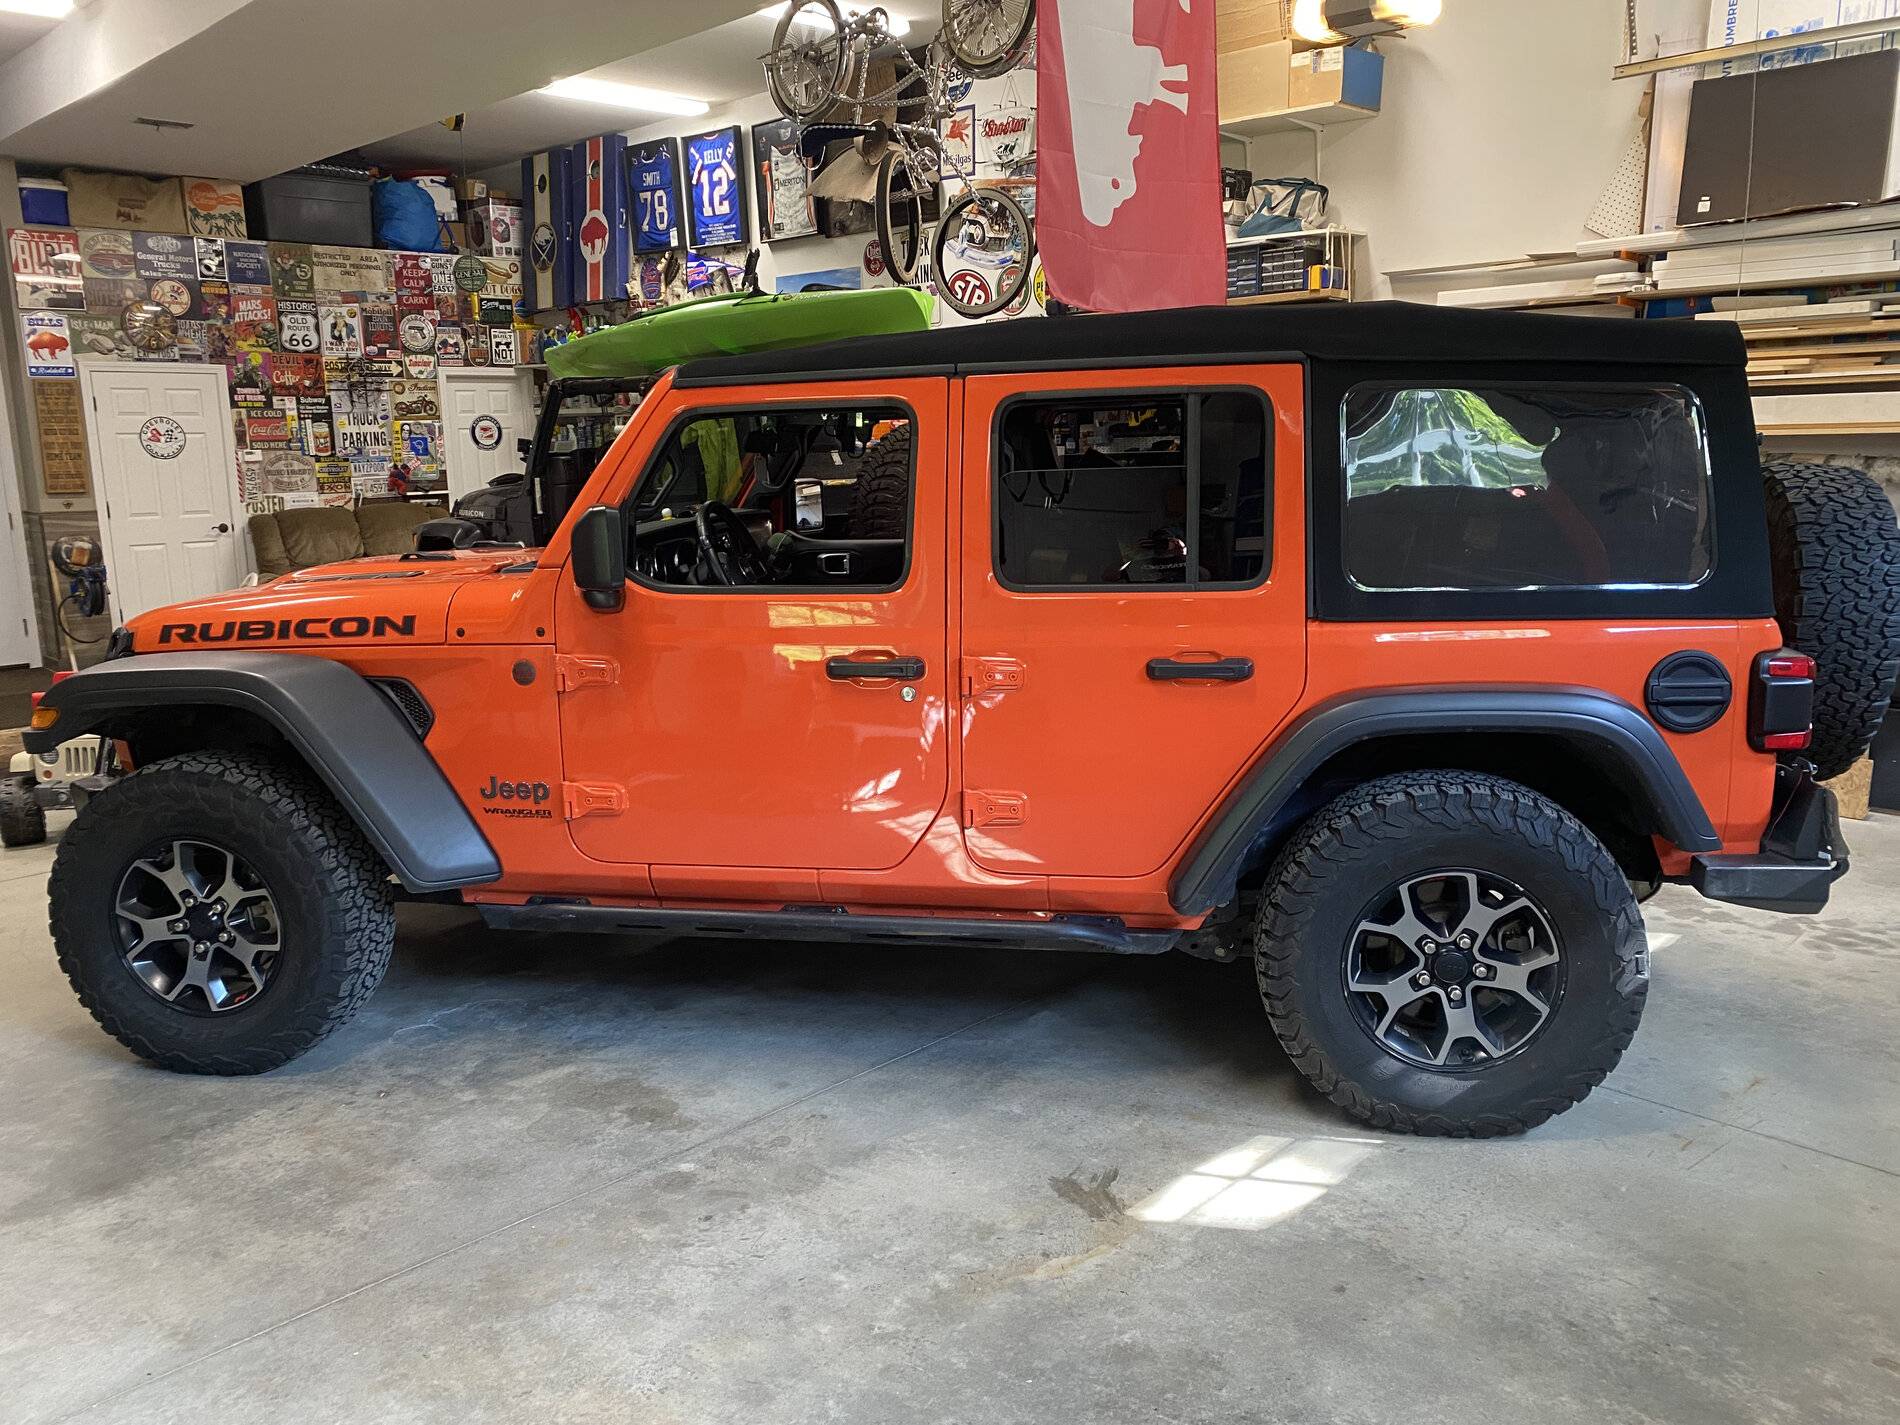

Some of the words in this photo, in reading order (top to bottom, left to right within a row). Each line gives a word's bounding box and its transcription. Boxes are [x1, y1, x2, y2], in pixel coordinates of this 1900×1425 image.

[704, 148, 723, 165] KELLY
[642, 172, 661, 187] SMITH
[700, 166, 731, 217] 12
[639, 189, 669, 232] 78
[137, 252, 167, 262] General
[169, 256, 195, 264] Motors
[153, 261, 181, 269] Trucks
[403, 279, 425, 287] CALM
[953, 275, 986, 306] STP
[238, 301, 263, 311] MARS
[278, 302, 317, 311] HISTORIC
[235, 309, 271, 323] ATTACKS!
[289, 316, 308, 325] OLD
[288, 334, 312, 348] 66
[330, 341, 346, 349] WANT
[494, 347, 514, 360] NOT
[271, 355, 301, 365] DEVIL
[407, 383, 438, 392] Indian
[299, 397, 325, 405] Subway
[252, 441, 269, 449] SOLD
[342, 431, 387, 450] PARKING
[353, 462, 386, 475] WAY2POOR
[320, 484, 352, 492] EXXON
[158, 615, 418, 645] RUBICON
[480, 775, 551, 805] Jeep
[483, 807, 553, 816] WRANGLER
